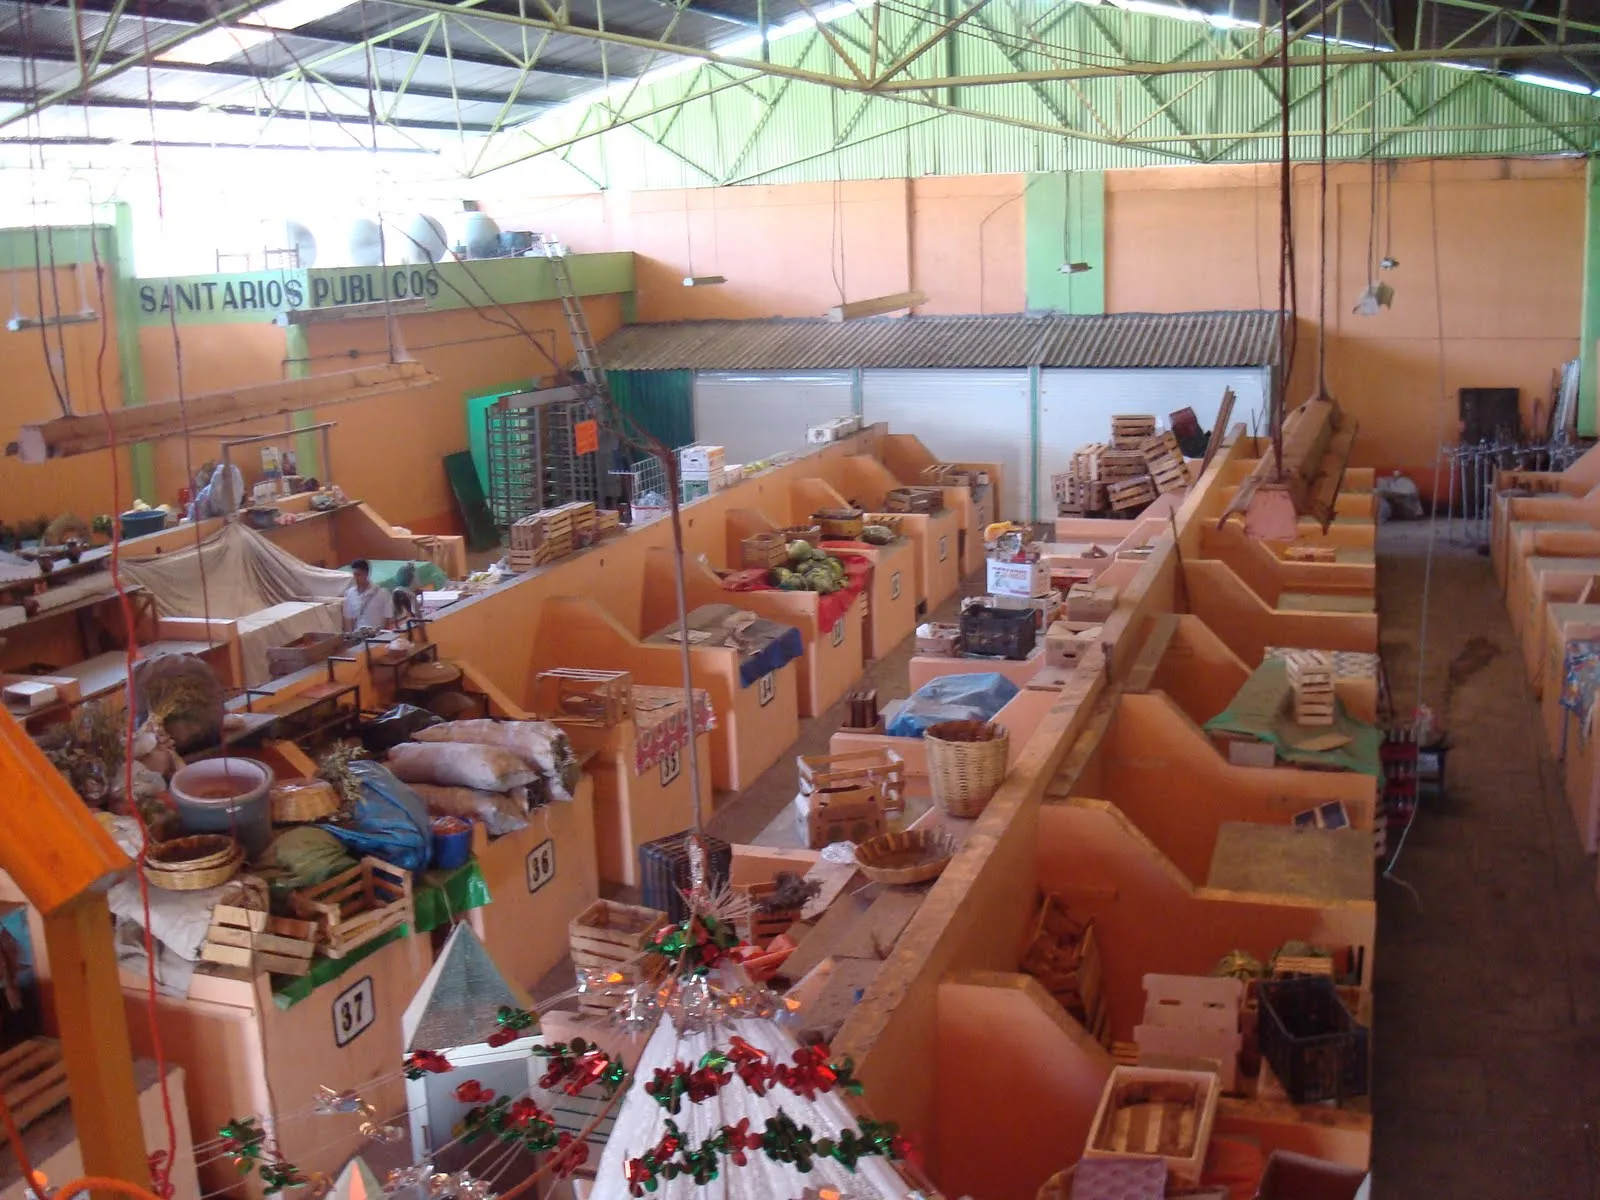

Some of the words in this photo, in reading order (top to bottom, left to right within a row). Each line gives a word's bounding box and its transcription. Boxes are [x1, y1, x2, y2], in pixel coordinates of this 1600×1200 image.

[139, 279, 303, 313] SANITARIOS
[312, 269, 439, 307] PUBLCOS
[532, 850, 549, 882] 36
[341, 991, 364, 1032] 37
